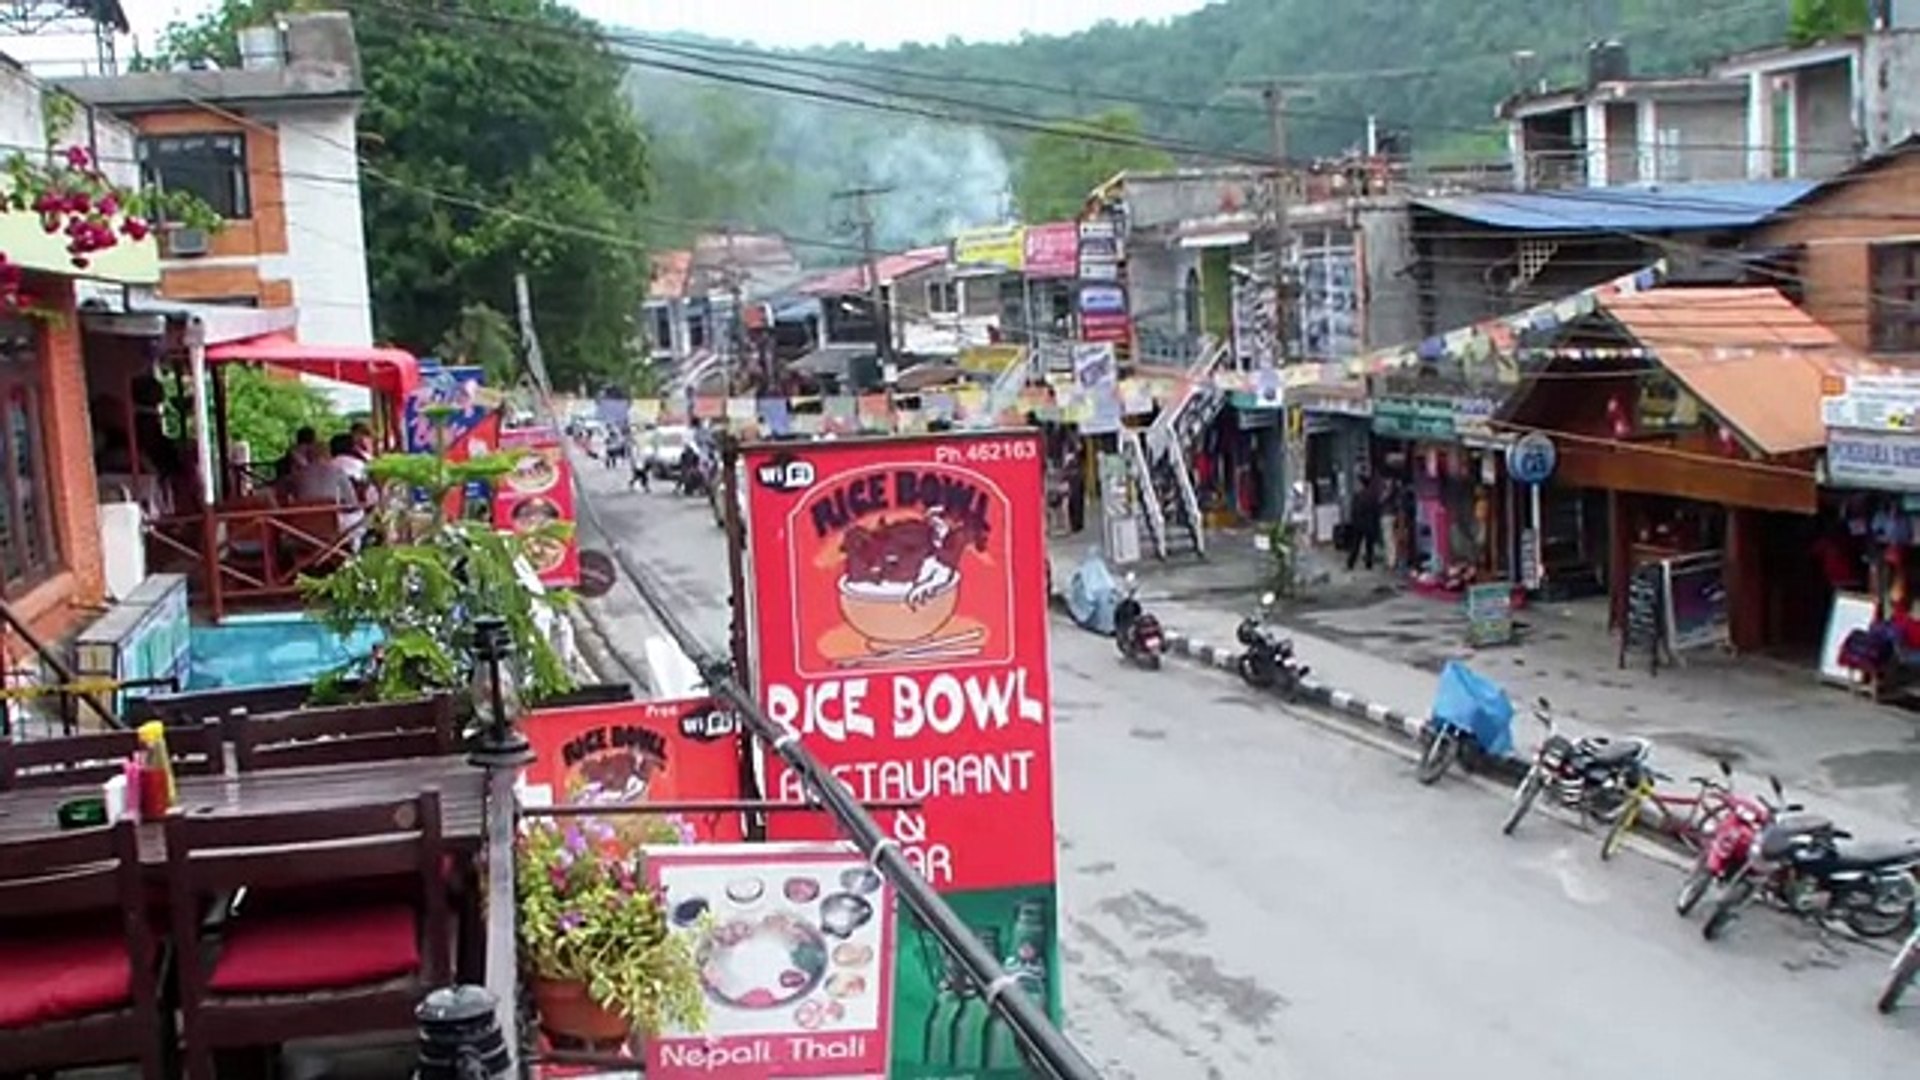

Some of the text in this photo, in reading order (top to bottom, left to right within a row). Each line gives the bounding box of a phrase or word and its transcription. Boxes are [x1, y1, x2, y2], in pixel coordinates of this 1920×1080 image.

[811, 471, 991, 551] RICE BOWL
[645, 706, 677, 717] Free
[768, 669, 1043, 741] RICE BOWL
[563, 725, 667, 771] RICE BOWL
[780, 752, 1034, 803] RSTAURANT
[894, 811, 926, 840] &
[903, 845, 953, 883] AR
[660, 1036, 865, 1069] Nepali Thali
